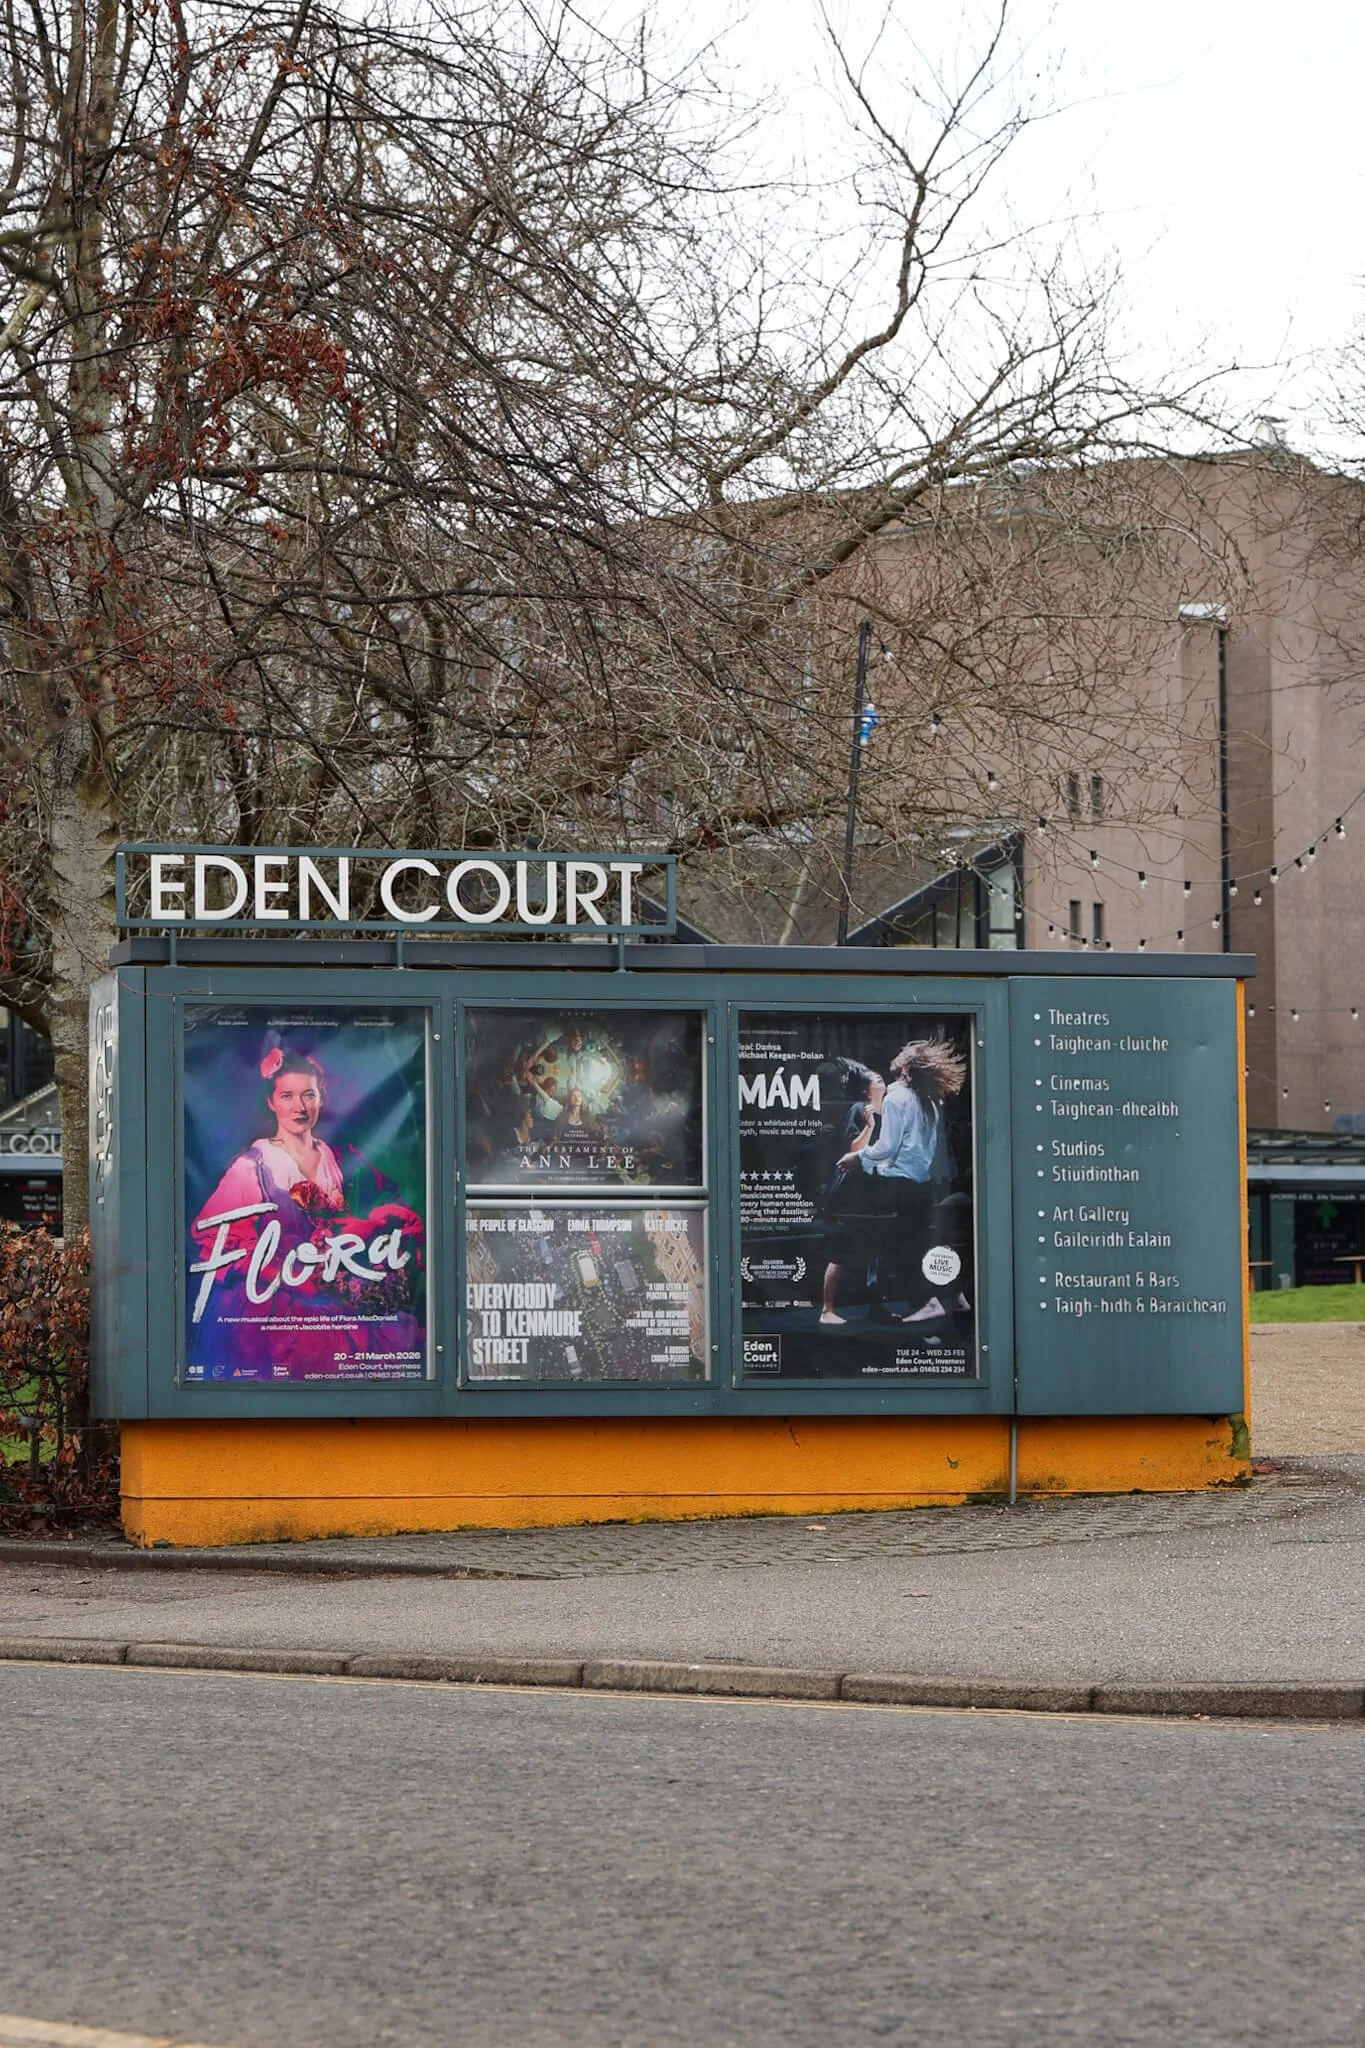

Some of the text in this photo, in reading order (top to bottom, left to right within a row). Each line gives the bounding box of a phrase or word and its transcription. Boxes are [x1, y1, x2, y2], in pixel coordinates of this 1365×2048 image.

[150, 855, 643, 926] EDEN COURT
[1048, 1009, 1110, 1026] Theatres
[1049, 1034, 1169, 1055] Taighean-cluiche
[769, 1051, 824, 1061] Keegan-Dolan
[738, 1066, 821, 1111] MÁM
[1050, 1075, 1110, 1091] Cinemas
[1050, 1100, 1179, 1120] Taighean-dhealbh
[1051, 1140, 1105, 1157] Studios
[519, 1154, 635, 1169] ANN LEE
[775, 1192, 802, 1200] embody
[740, 1208, 762, 1217] during
[781, 1208, 808, 1217] dazzling
[1053, 1206, 1129, 1225] Art Gallery
[480, 1219, 506, 1231] PEOPLE
[507, 1219, 517, 1231] OF
[518, 1219, 554, 1231] GLASGOW
[568, 1219, 632, 1231] EMMA THOMPSON
[1128, 1231, 1171, 1248] Ealain
[1055, 1271, 1180, 1288] Restaurant & Bars
[466, 1283, 556, 1309] EVERYBODY
[1136, 1297, 1145, 1313] &
[480, 1310, 582, 1336] TO KENMURE
[473, 1338, 529, 1364] STREET
[744, 1341, 772, 1351] Eden
[334, 1352, 347, 1360] 20
[354, 1352, 365, 1360] 21
[366, 1352, 395, 1360] March
[396, 1351, 421, 1359] 2026
[743, 1351, 778, 1362] Court
